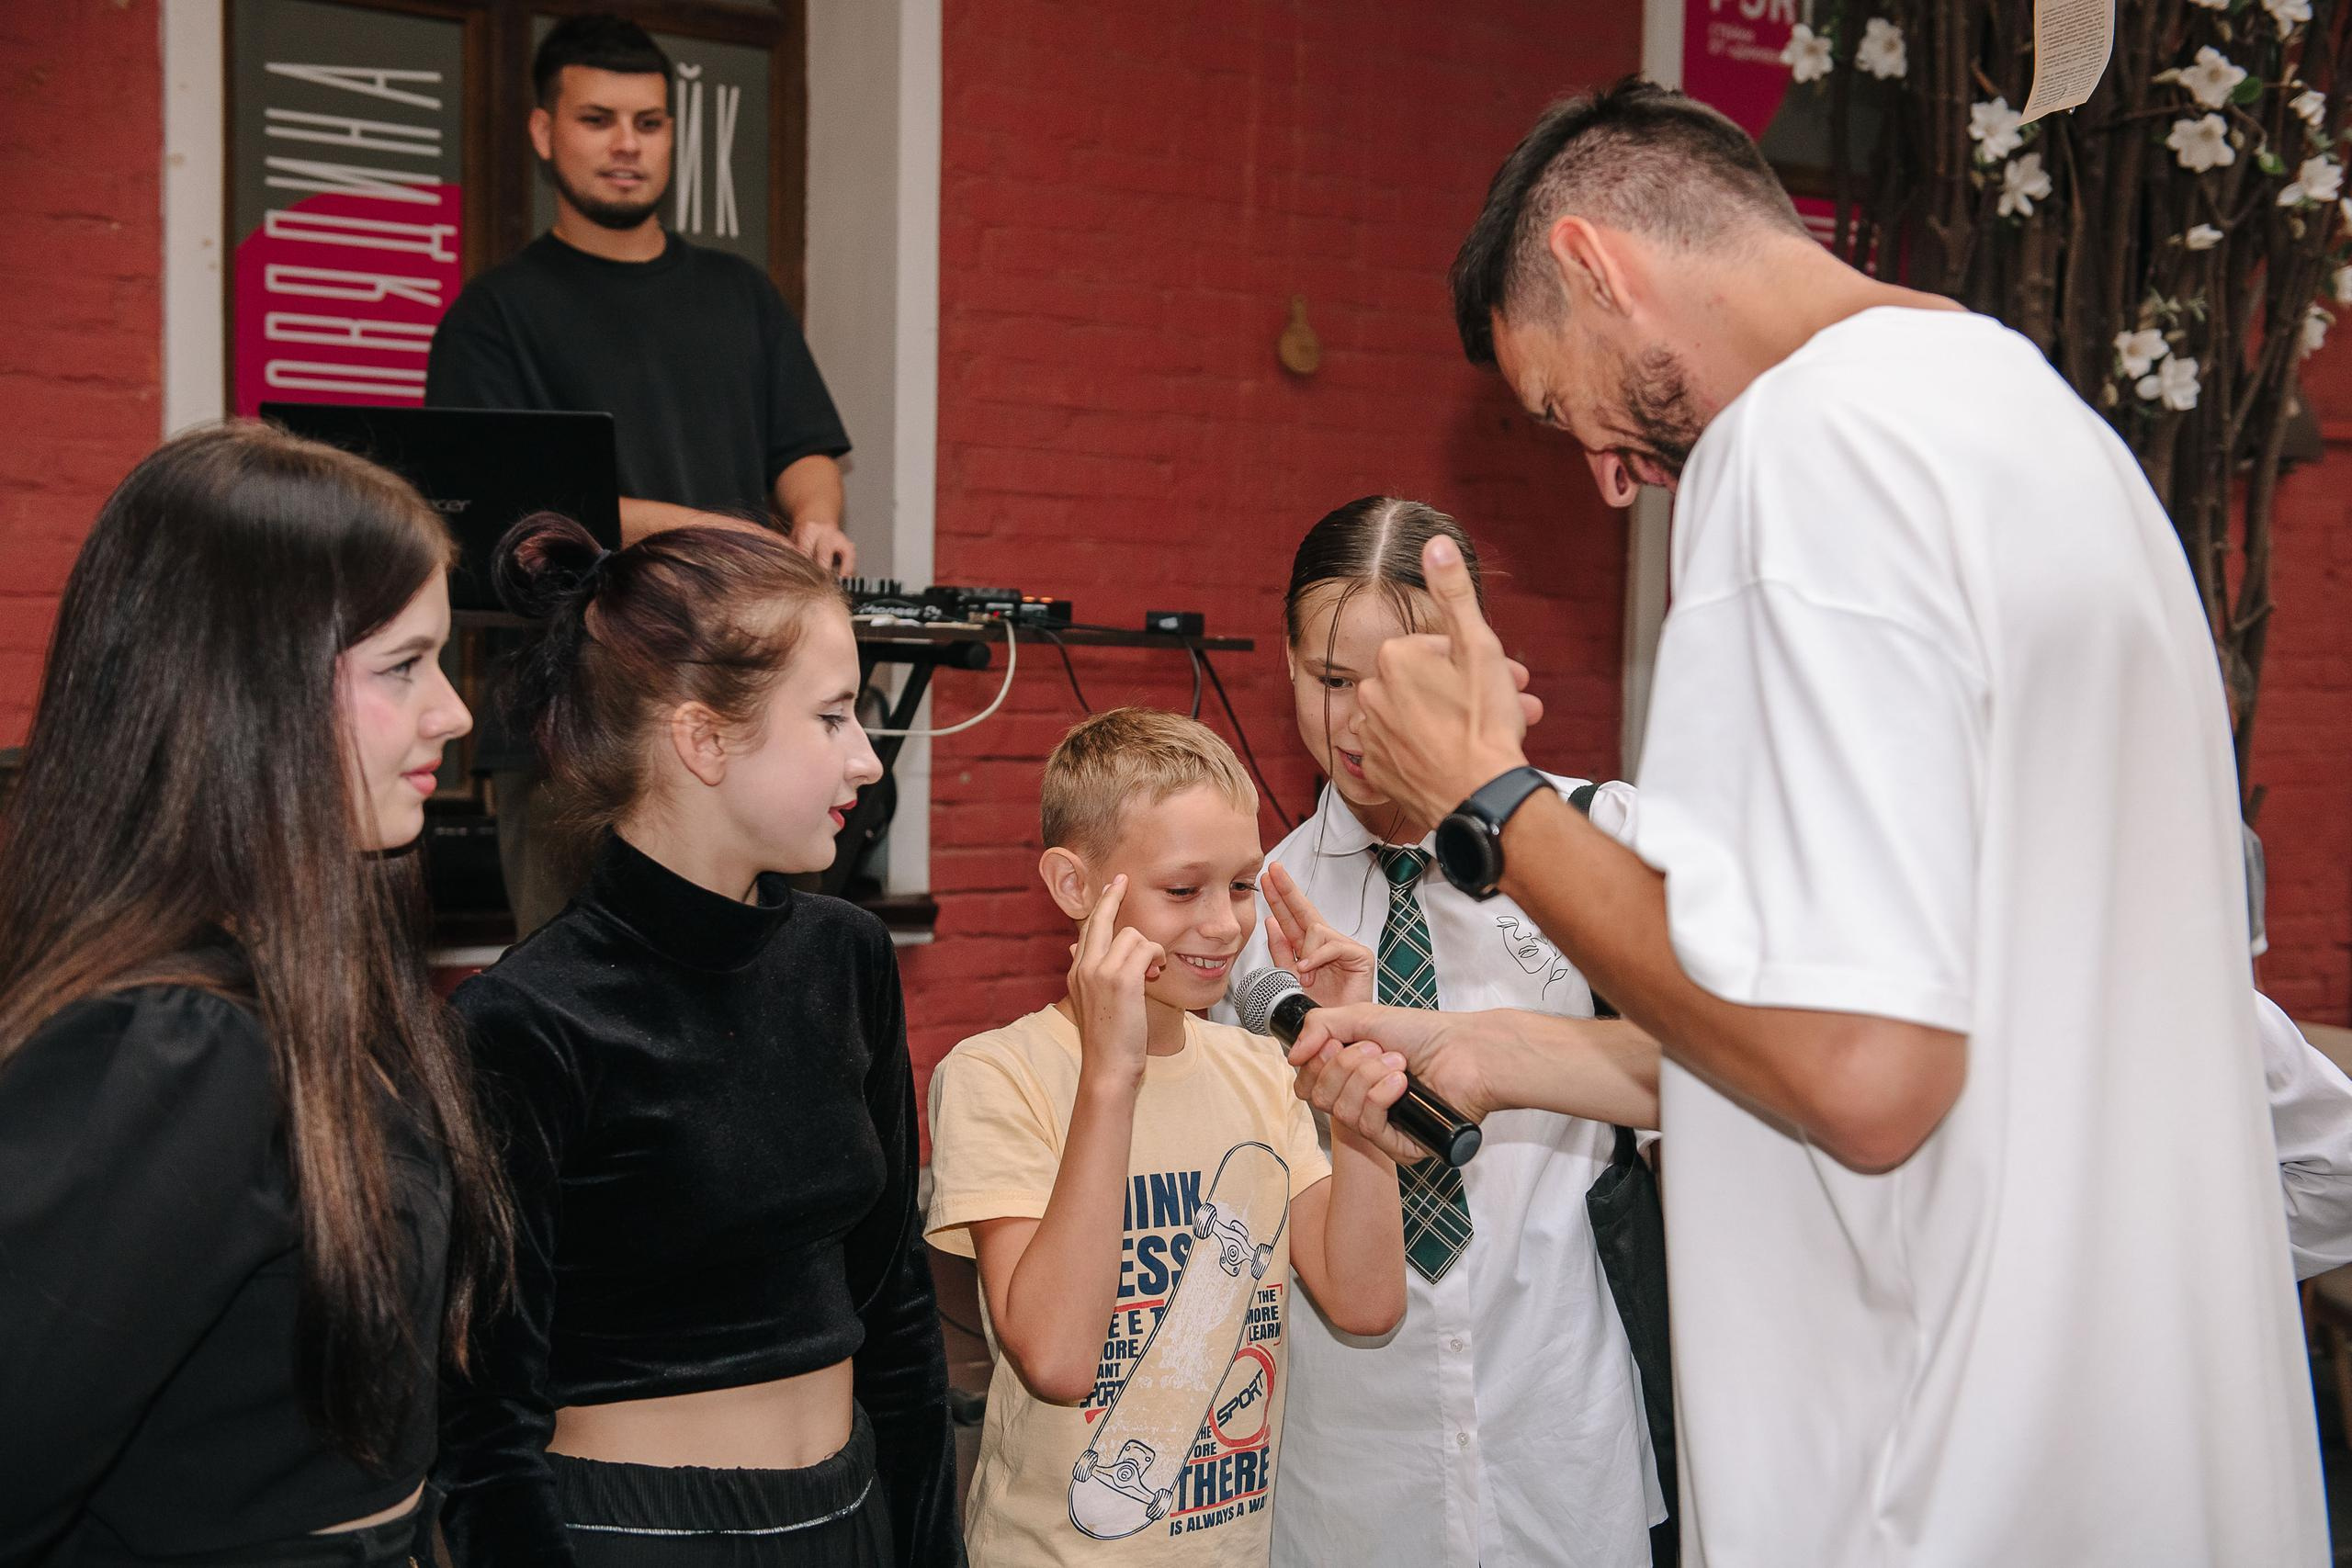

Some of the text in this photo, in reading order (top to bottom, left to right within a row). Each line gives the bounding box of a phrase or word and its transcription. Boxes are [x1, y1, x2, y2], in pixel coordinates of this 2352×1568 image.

[265, 62, 458, 399] ОВЯДИНА
[1124, 1171, 1202, 1231] INK
[1117, 1233, 1193, 1298] ESS
[1257, 1289, 1277, 1304] THE
[1096, 1362, 1121, 1379] ANT
[1100, 1339, 1140, 1361] ORE
[1216, 1369, 1263, 1428] SPORT
[1193, 1442, 1217, 1458] ORE
[1177, 1445, 1270, 1512] THERE
[1170, 1520, 1182, 1536] IS
[1186, 1506, 1235, 1532] ALWAYS
[1236, 1502, 1245, 1517] A
